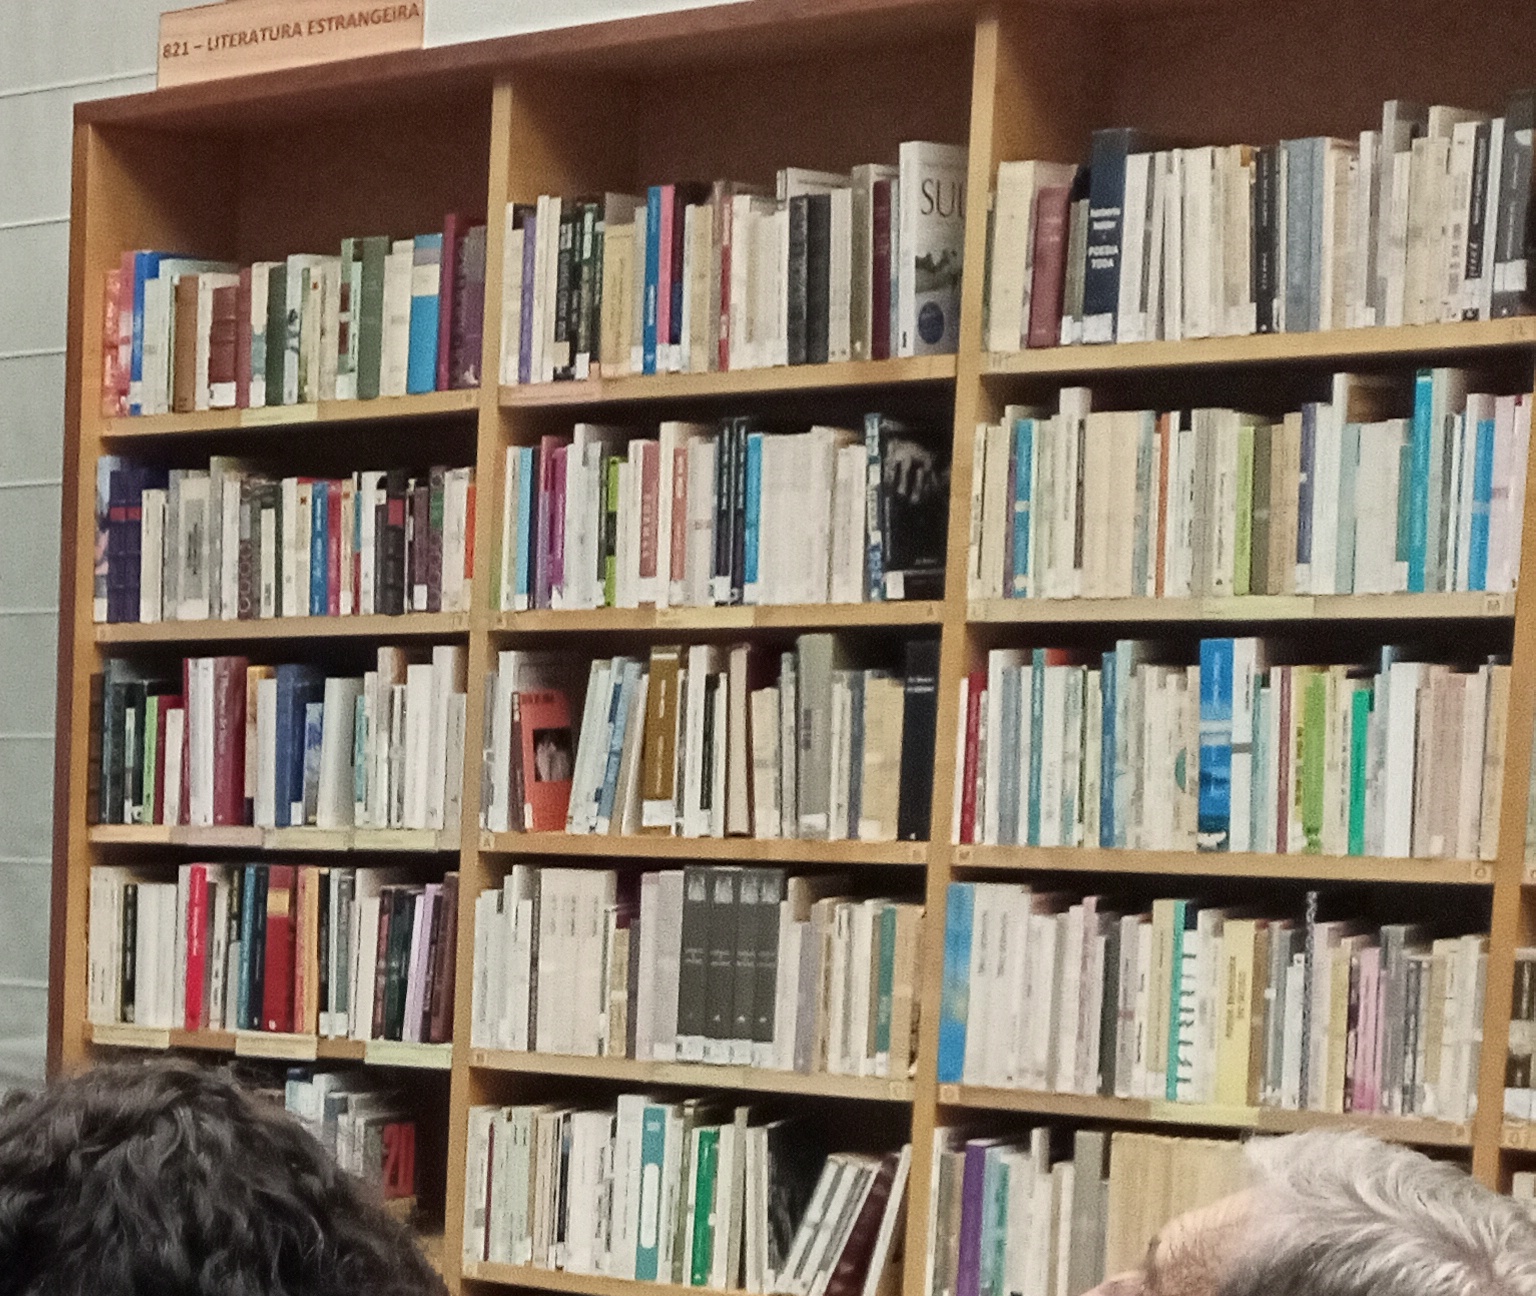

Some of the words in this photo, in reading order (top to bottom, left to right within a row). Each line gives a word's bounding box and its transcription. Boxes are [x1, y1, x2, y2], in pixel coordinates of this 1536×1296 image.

[162, 41, 190, 58] 821
[207, 21, 304, 52] LITERATURA
[307, 3, 421, 36] ESTRANGEIRA
